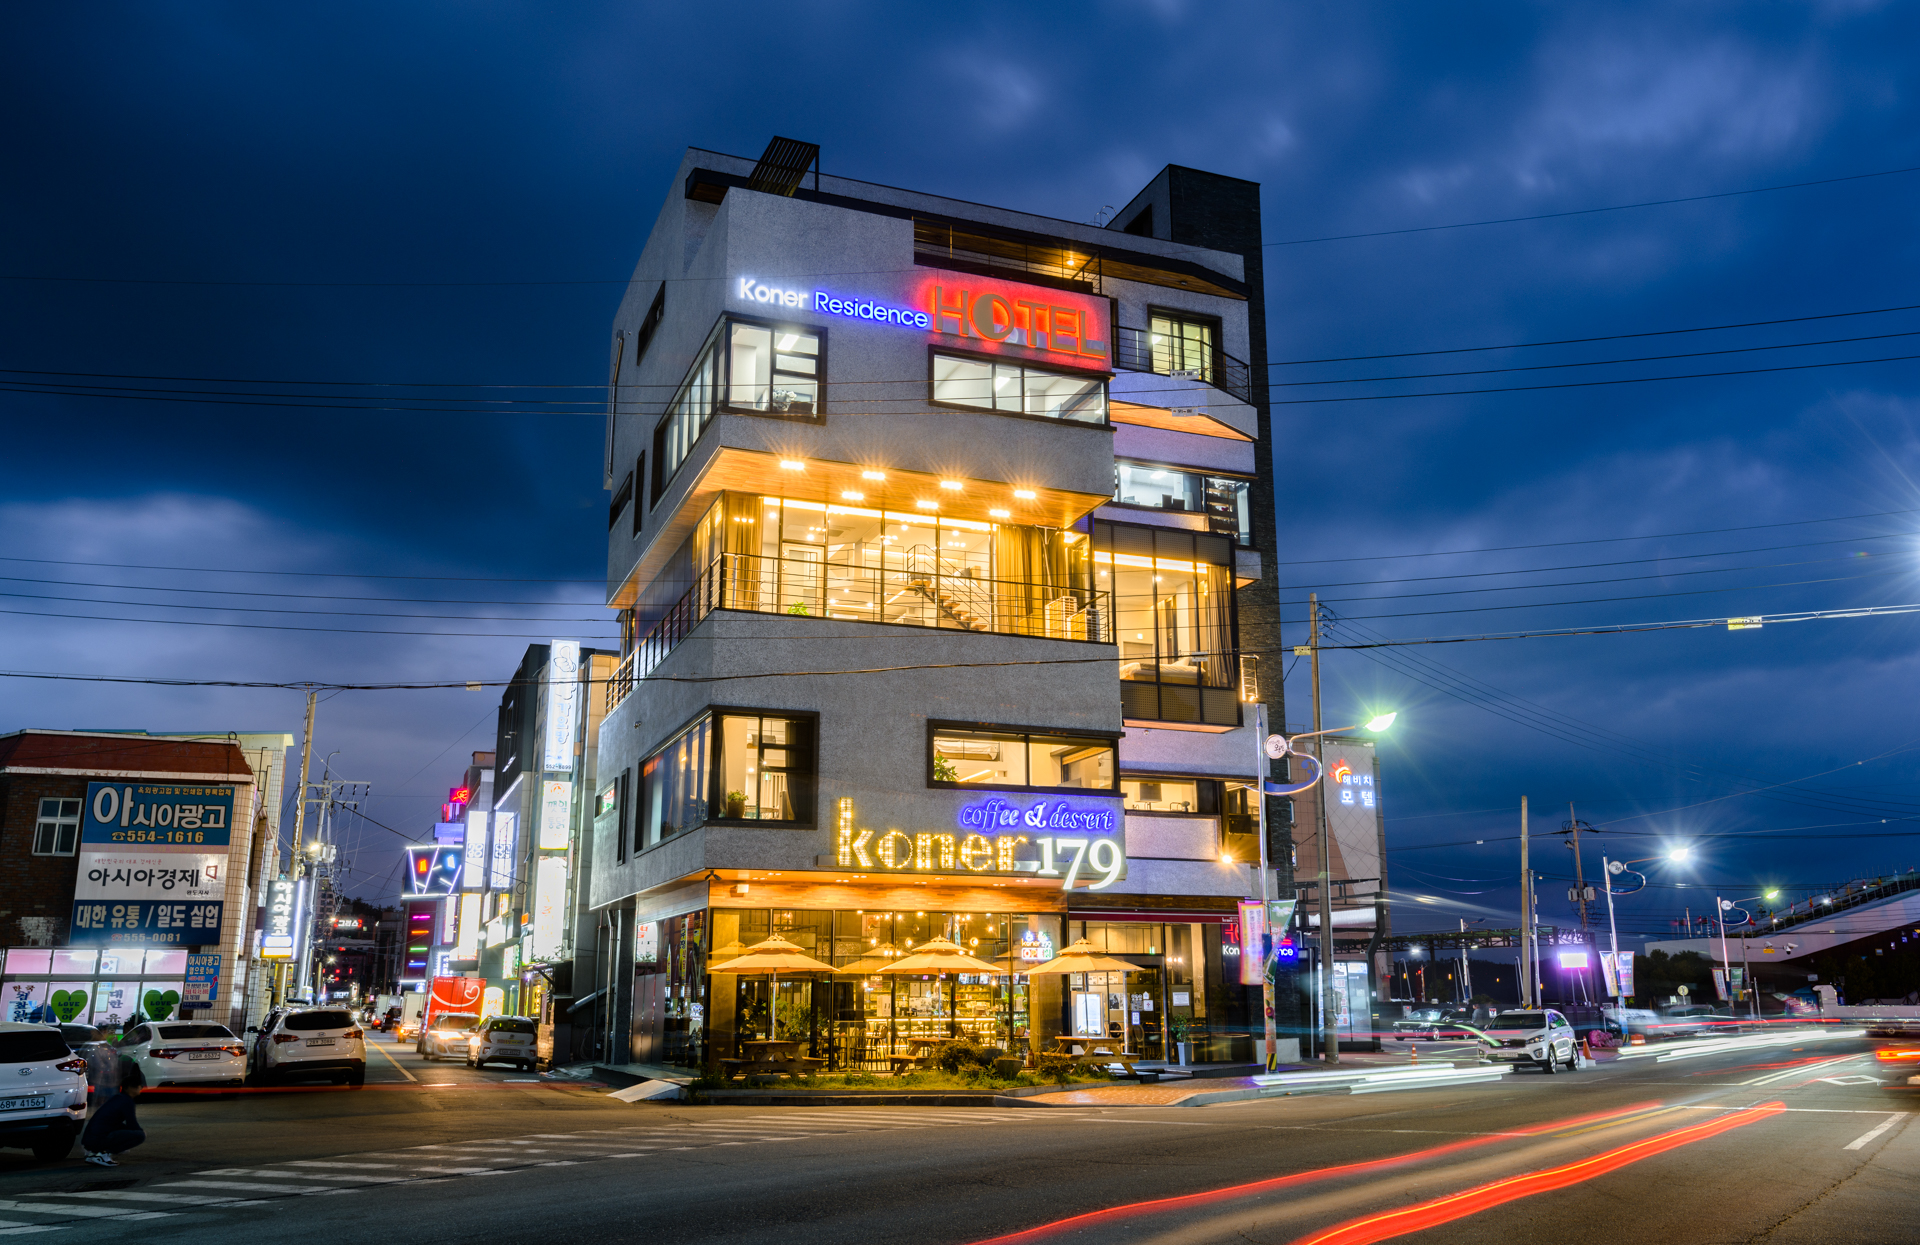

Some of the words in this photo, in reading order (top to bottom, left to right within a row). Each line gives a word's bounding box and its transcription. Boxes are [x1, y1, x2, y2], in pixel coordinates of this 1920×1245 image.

[739, 278, 808, 308] Koner
[814, 291, 929, 328] Residence
[934, 285, 1107, 359] HOTEL
[1342, 775, 1372, 786] 해비치
[174, 787, 180, 795] 및
[1341, 790, 1374, 806] 모텔
[92, 786, 227, 829] 아시아광고
[962, 799, 1019, 830] coffee
[1024, 802, 1047, 828] &
[1049, 803, 1113, 830] dessert
[126, 830, 204, 844] 554-1616
[837, 796, 1028, 872] koner
[1036, 837, 1122, 890] 179
[88, 868, 200, 890] 아시아경제
[271, 882, 294, 936] 아시아광고
[76, 905, 107, 929] 대한
[111, 905, 141, 929] 유통
[157, 905, 187, 928] 일도
[190, 905, 219, 928] 실업
[124, 933, 181, 943] 555-0081
[1022, 949, 1051, 958] OPEN
[1222, 945, 1240, 955] Kon
[189, 955, 220, 966] 아시아광고
[20, 1099, 41, 1108] 4156
